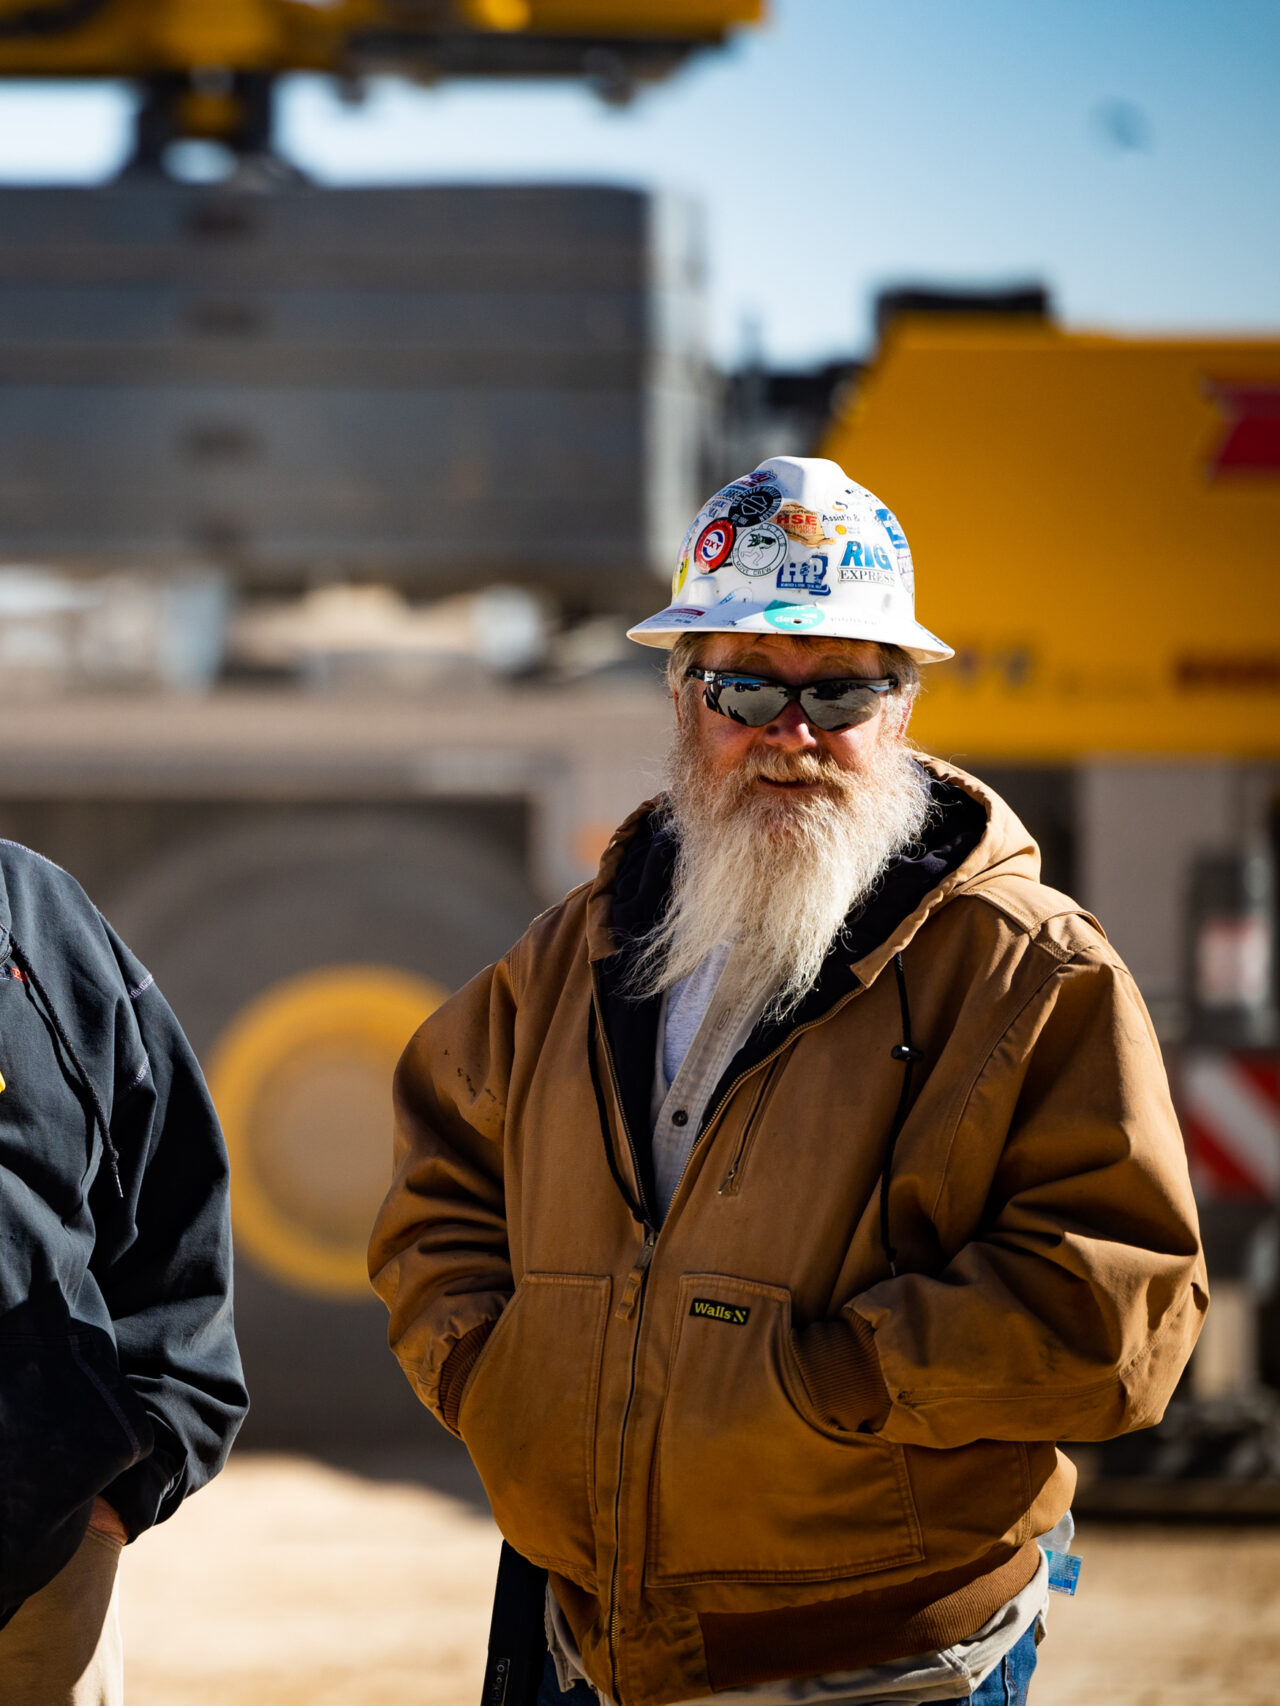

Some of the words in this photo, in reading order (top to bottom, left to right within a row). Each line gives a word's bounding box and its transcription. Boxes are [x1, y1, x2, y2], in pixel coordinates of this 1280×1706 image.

[776, 514, 817, 526] HSE
[704, 538, 722, 551] OXY
[840, 540, 894, 571] RIG
[840, 570, 896, 583] EXPRESS
[694, 1302, 733, 1320] Walls
